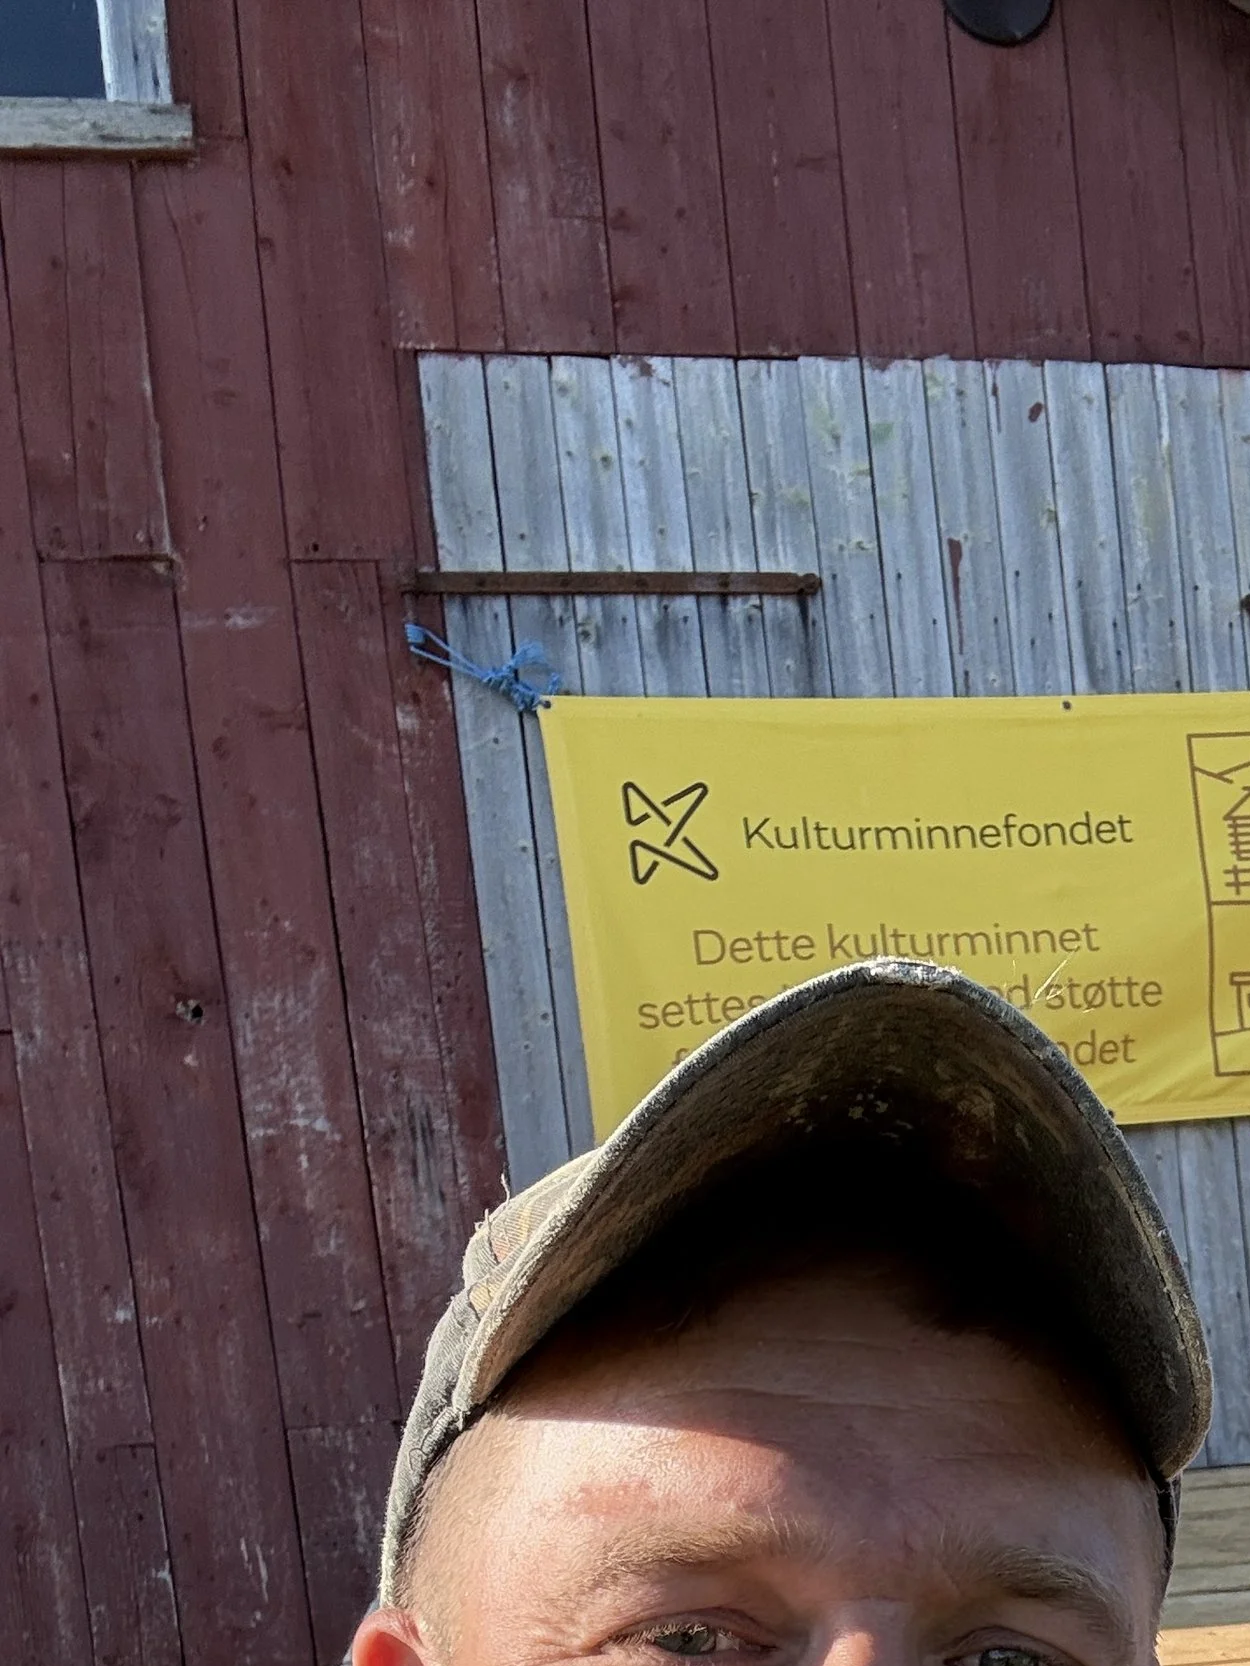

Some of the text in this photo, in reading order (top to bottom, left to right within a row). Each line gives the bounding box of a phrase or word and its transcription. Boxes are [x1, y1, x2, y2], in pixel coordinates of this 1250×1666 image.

[742, 811, 1133, 851] Kulturminnefondet
[693, 922, 1101, 966] Dette kulturminnet
[1044, 976, 1163, 1010] støtte
